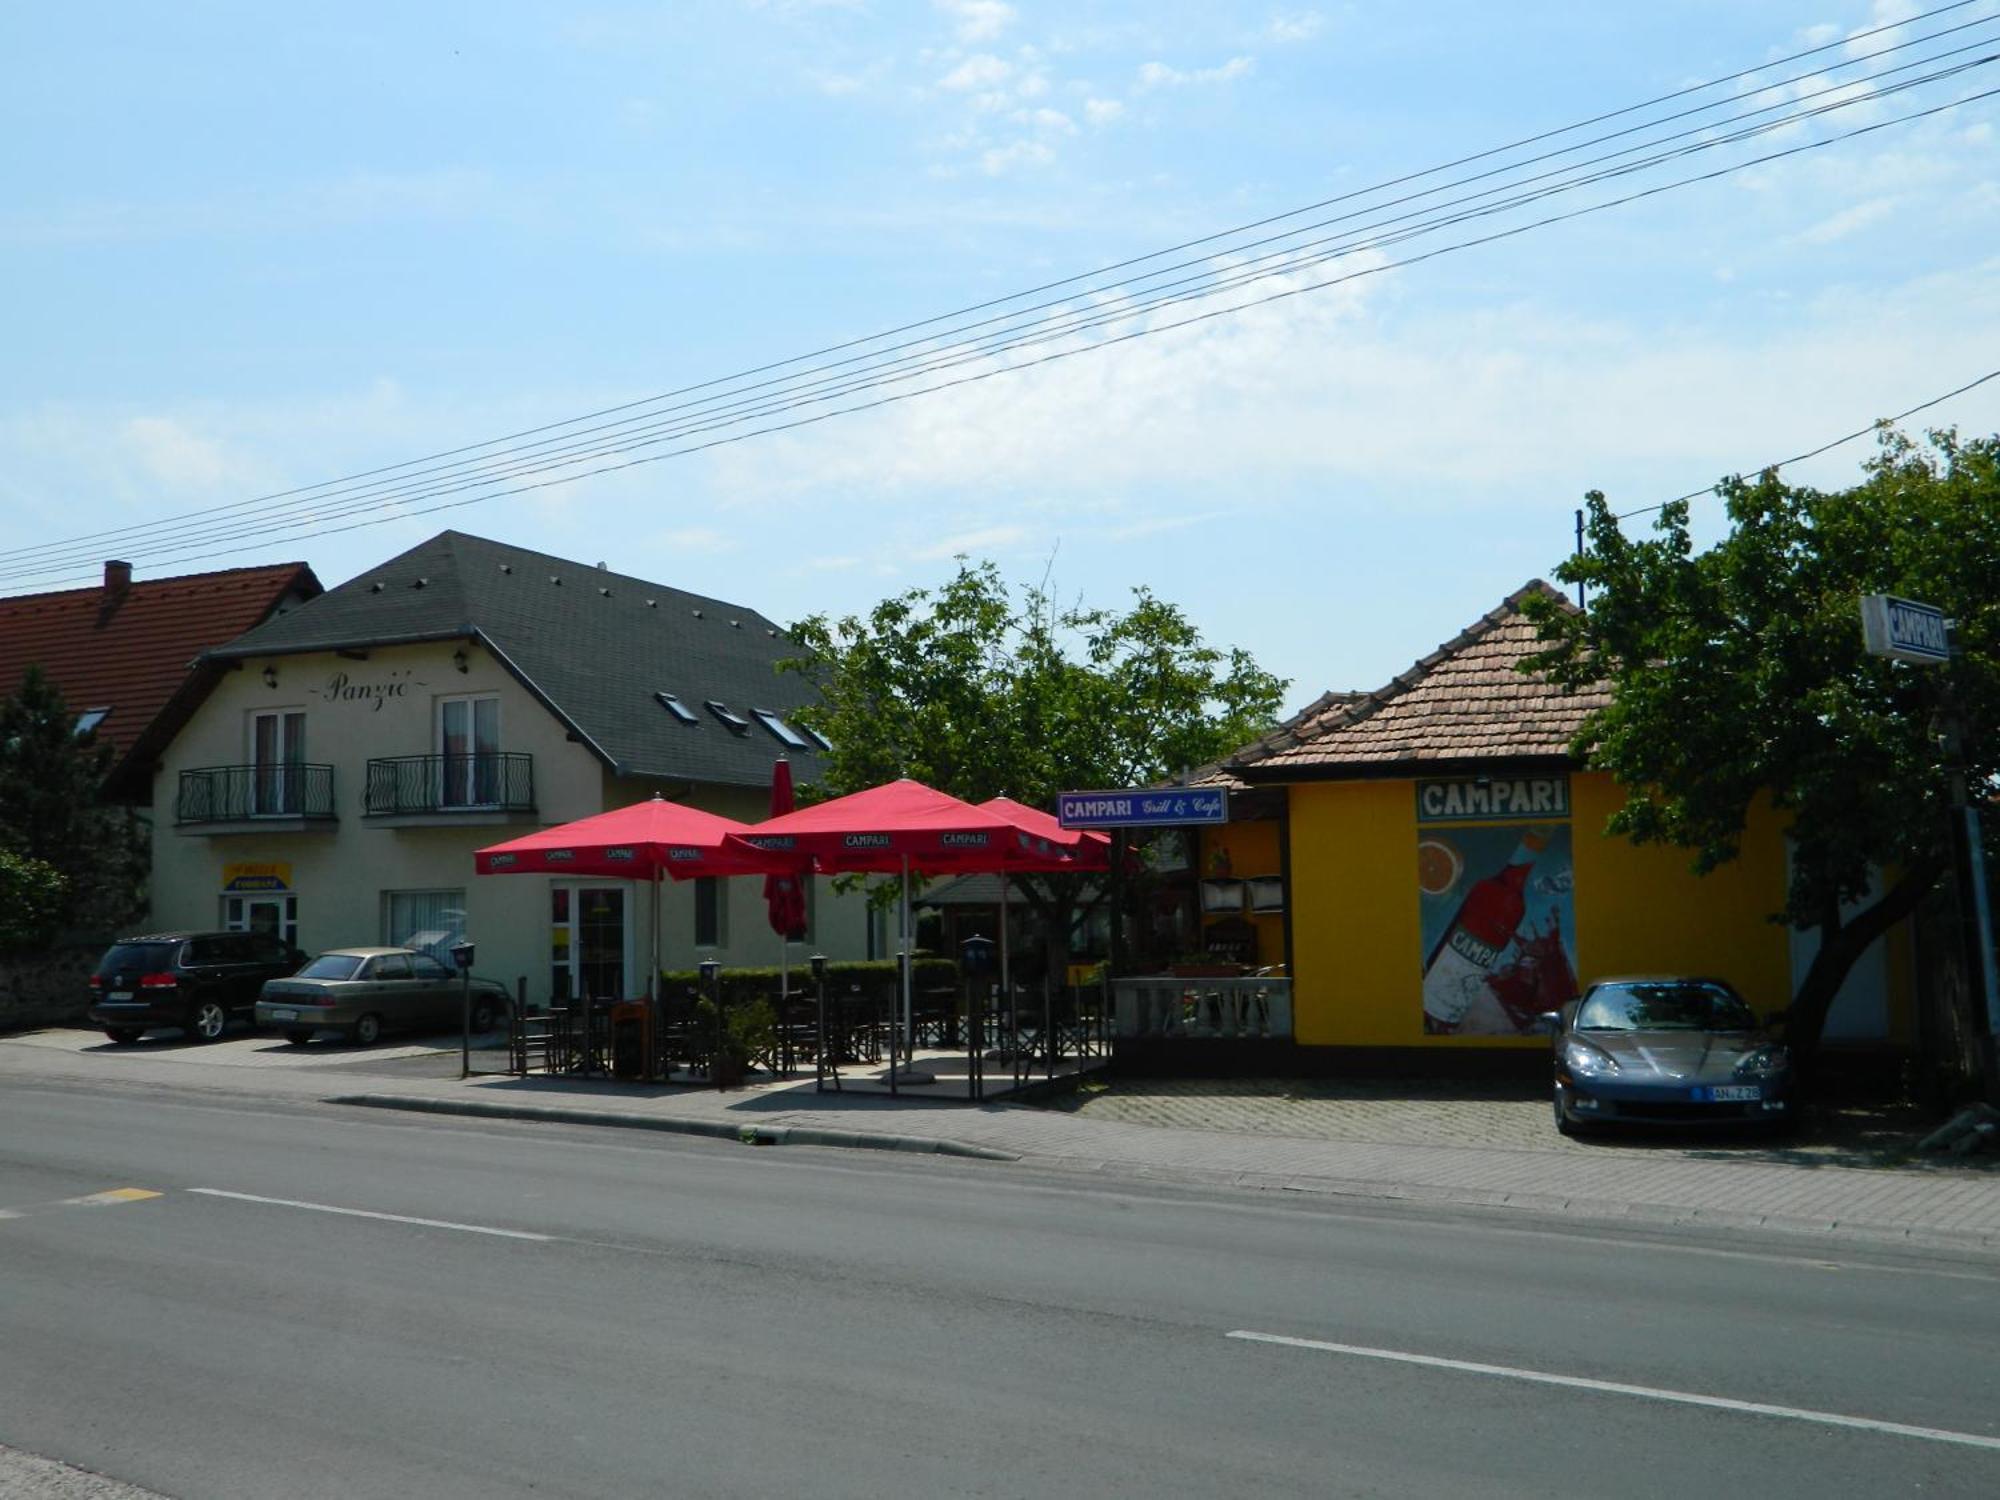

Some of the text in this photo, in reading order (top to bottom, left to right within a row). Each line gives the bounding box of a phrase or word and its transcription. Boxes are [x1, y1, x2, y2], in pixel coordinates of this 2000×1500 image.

[1889, 606, 1945, 650] CAMPARI
[1424, 780, 1564, 815] CAMPARI
[1064, 801, 1132, 817] CAMPARI
[1142, 799, 1171, 814] Grill
[845, 835, 889, 846] CAMPARI
[943, 834, 987, 844] CAMPARI
